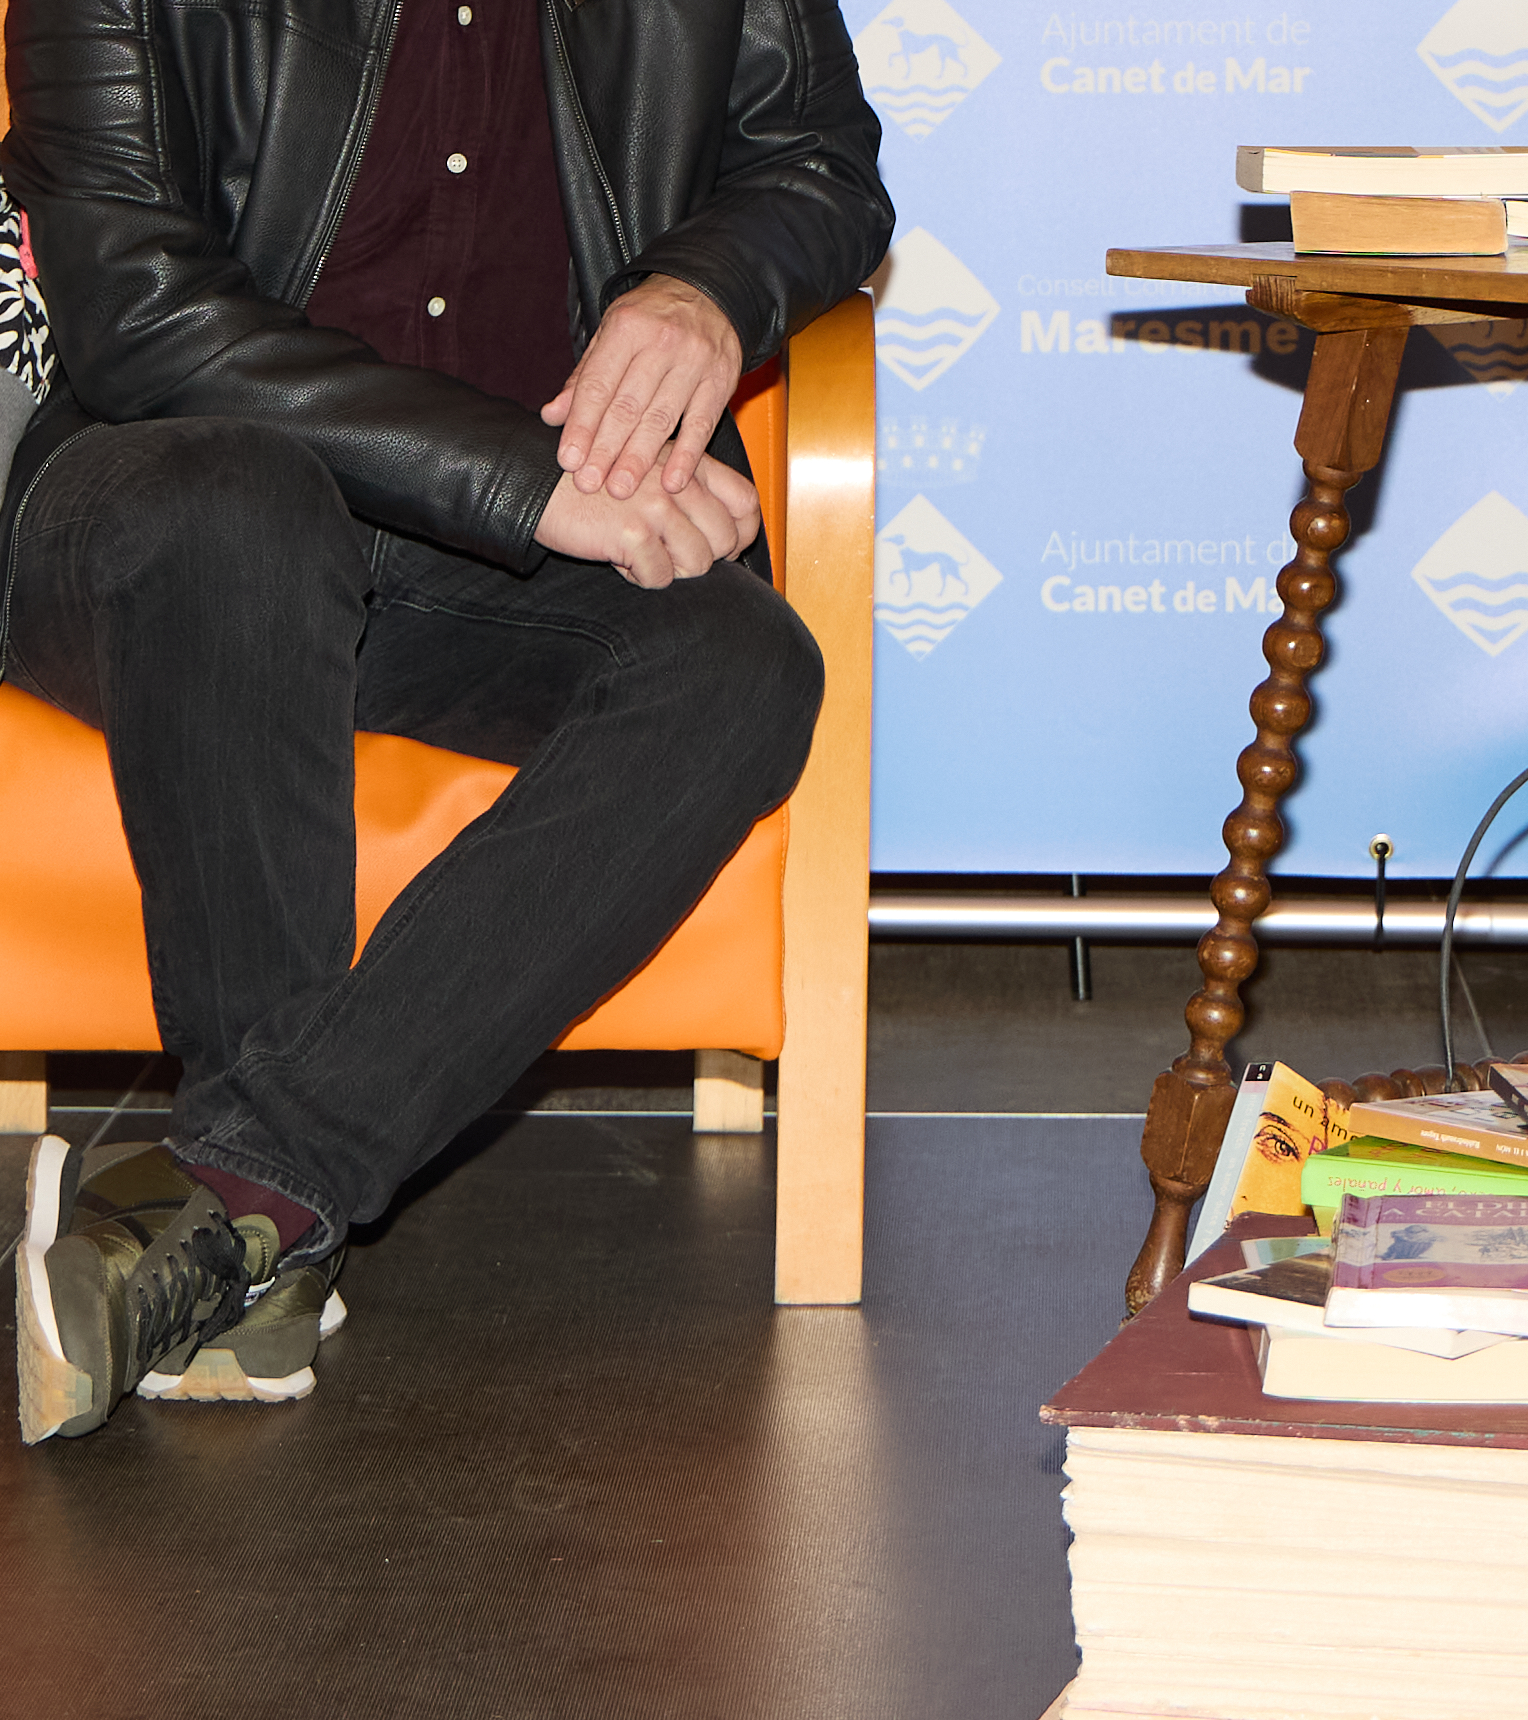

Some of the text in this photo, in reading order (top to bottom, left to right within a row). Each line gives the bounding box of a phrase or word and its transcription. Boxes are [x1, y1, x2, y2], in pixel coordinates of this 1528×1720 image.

[1040, 56, 1312, 94] Canet de Mar
[1020, 309, 1301, 355] Maresme
[1040, 529, 1257, 571] Ajuntament
[1040, 574, 1167, 614] Canet
[1173, 579, 1218, 614] de
[1292, 1094, 1315, 1120] un
[1327, 1175, 1404, 1192] y pañales
[1382, 1206, 1406, 1218] A
